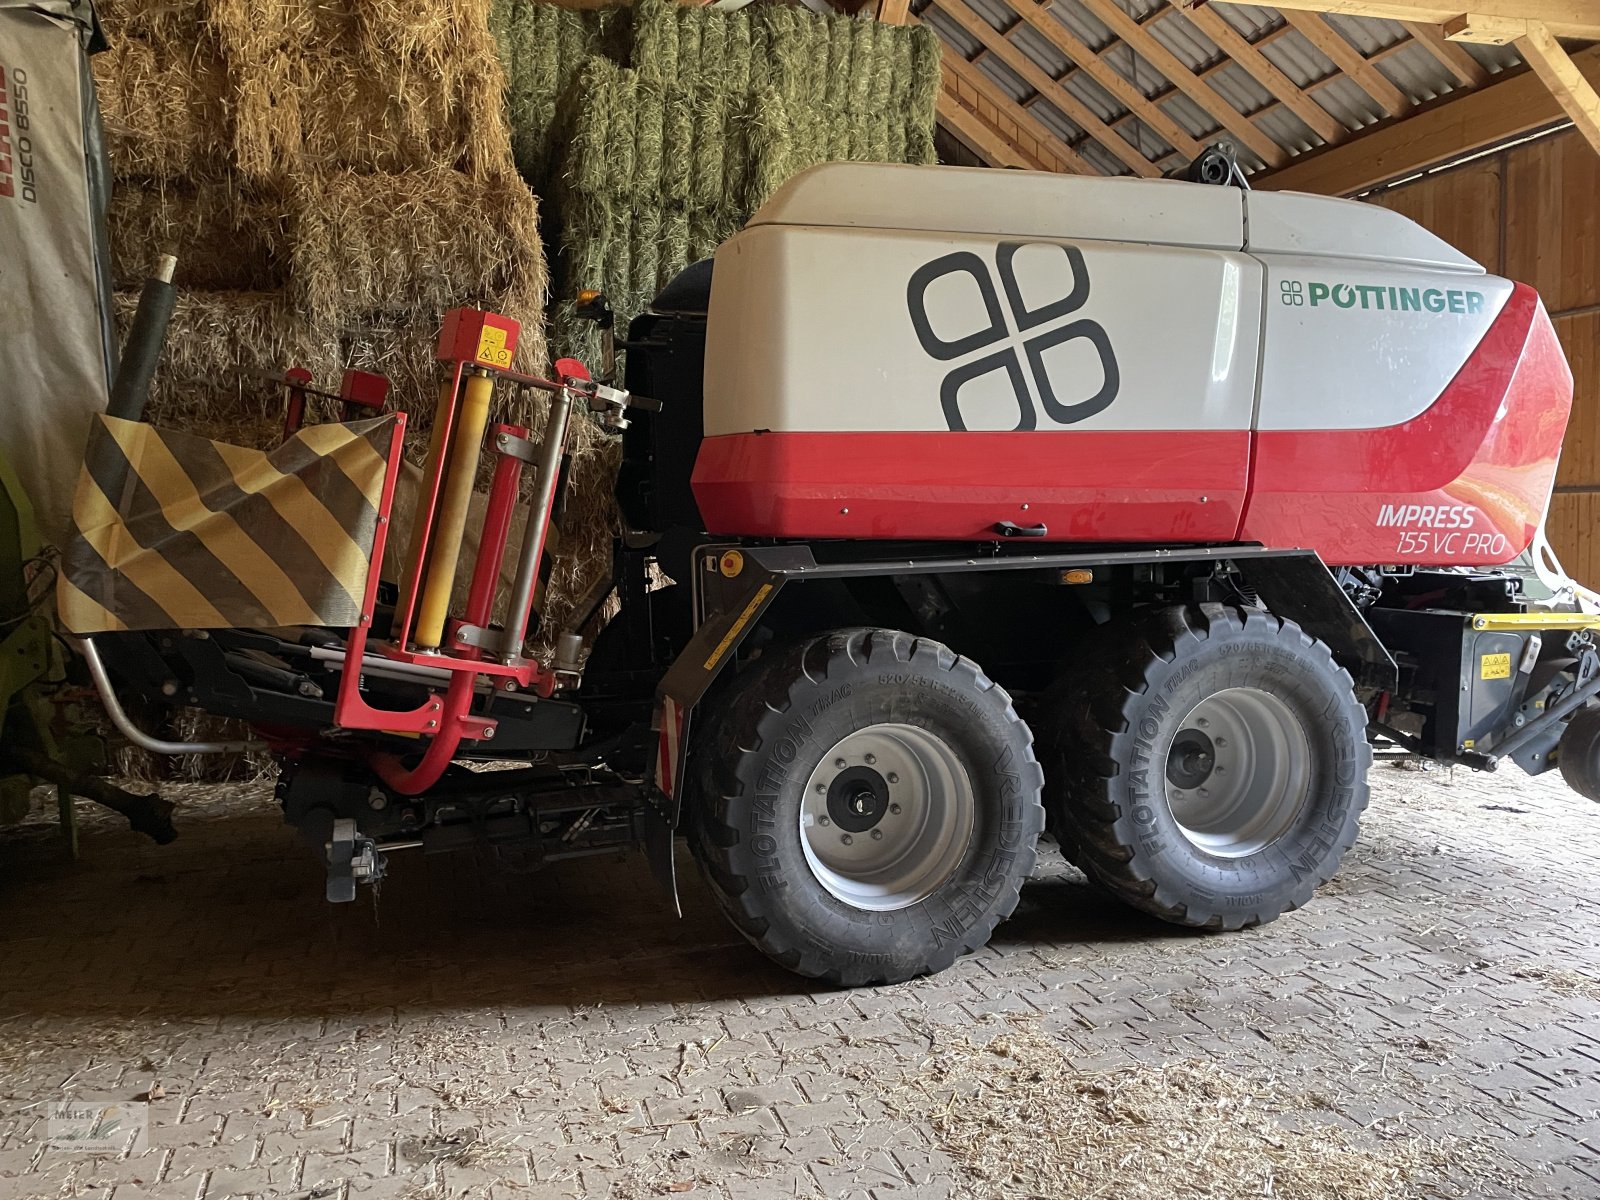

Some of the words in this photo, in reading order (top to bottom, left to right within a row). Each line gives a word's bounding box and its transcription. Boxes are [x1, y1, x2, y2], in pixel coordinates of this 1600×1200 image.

[13, 68, 30, 132] 8550
[18, 136, 37, 204] DISCO
[1376, 504, 1477, 529] IMPRESS
[1397, 531, 1430, 554] 155
[1434, 532, 1461, 554] VC
[1462, 533, 1506, 555] PRO
[752, 715, 814, 895] FLOTATION
[810, 682, 853, 717] TRAC
[1129, 693, 1170, 858] FLOTATION
[1164, 658, 1199, 694] TRAC
[1288, 692, 1356, 885] VREDESTEIN
[931, 744, 1024, 950] VREDESTEIN
